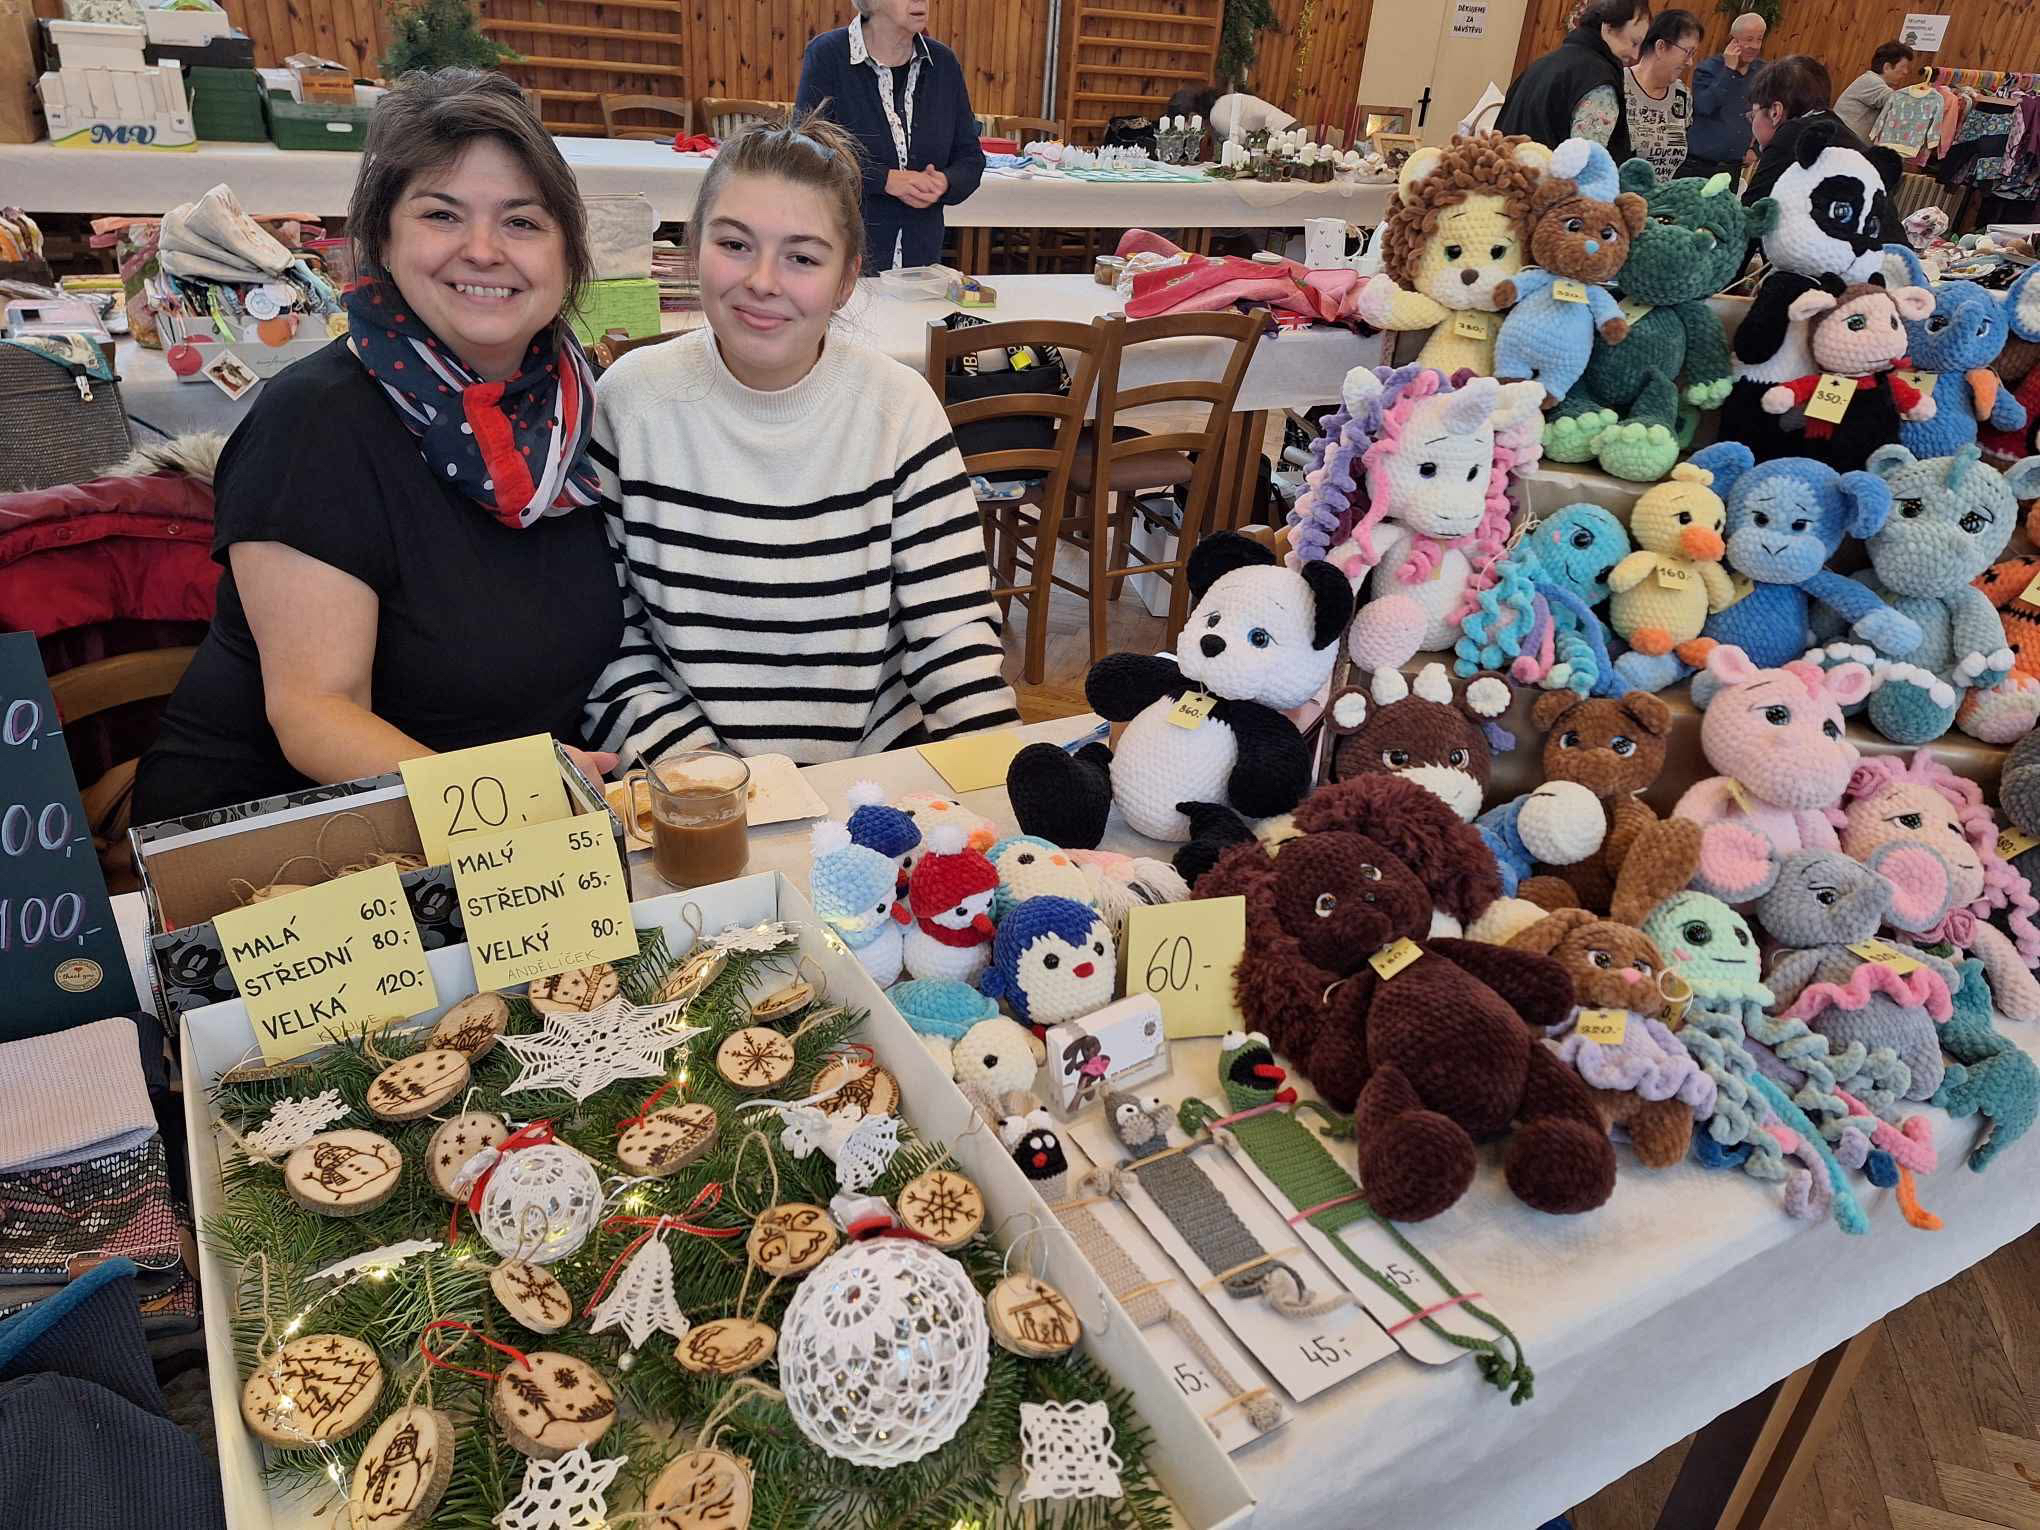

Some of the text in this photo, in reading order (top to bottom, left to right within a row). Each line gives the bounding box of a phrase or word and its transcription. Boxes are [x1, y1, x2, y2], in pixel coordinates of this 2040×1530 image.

[91, 123, 156, 144] MV
[457, 830, 604, 875] MALÝ 55,-
[467, 872, 566, 917] STŘEDNÍ
[231, 898, 397, 963] MALÁ 60,-
[477, 918, 624, 965] VELKÝ 80,-
[244, 929, 411, 997] STŘEDNÍ 80,-
[261, 969, 425, 1040] VELKÁ 120,-
